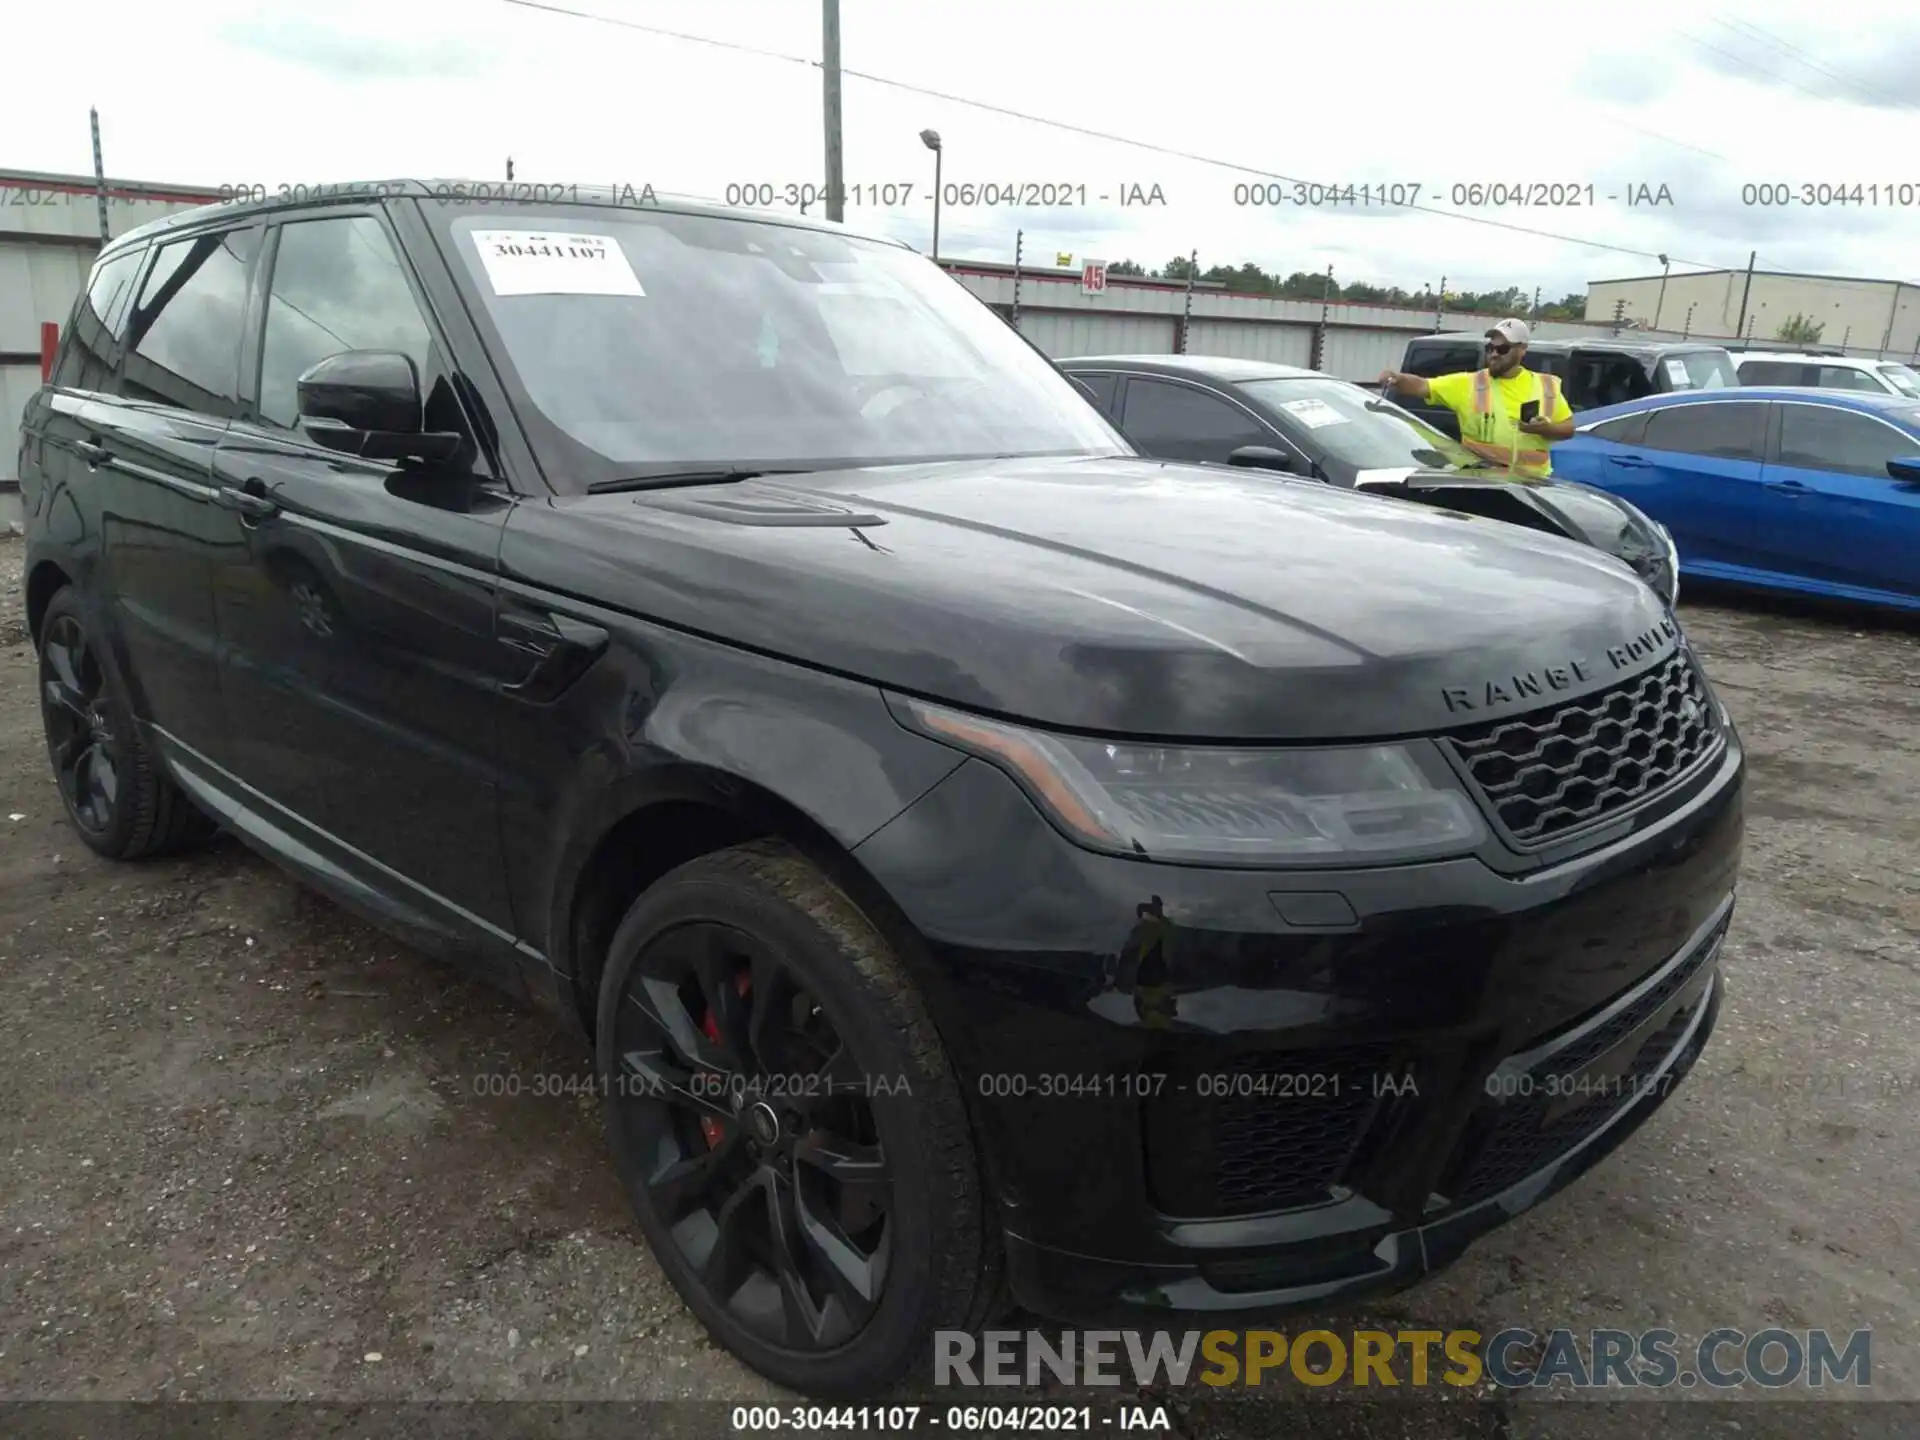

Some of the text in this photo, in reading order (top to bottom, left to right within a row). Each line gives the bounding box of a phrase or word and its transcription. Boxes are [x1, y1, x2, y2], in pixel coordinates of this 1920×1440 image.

[494, 243, 605, 259] 30441107
[1083, 265, 1104, 290] 45
[1441, 660, 1597, 713] RANGE
